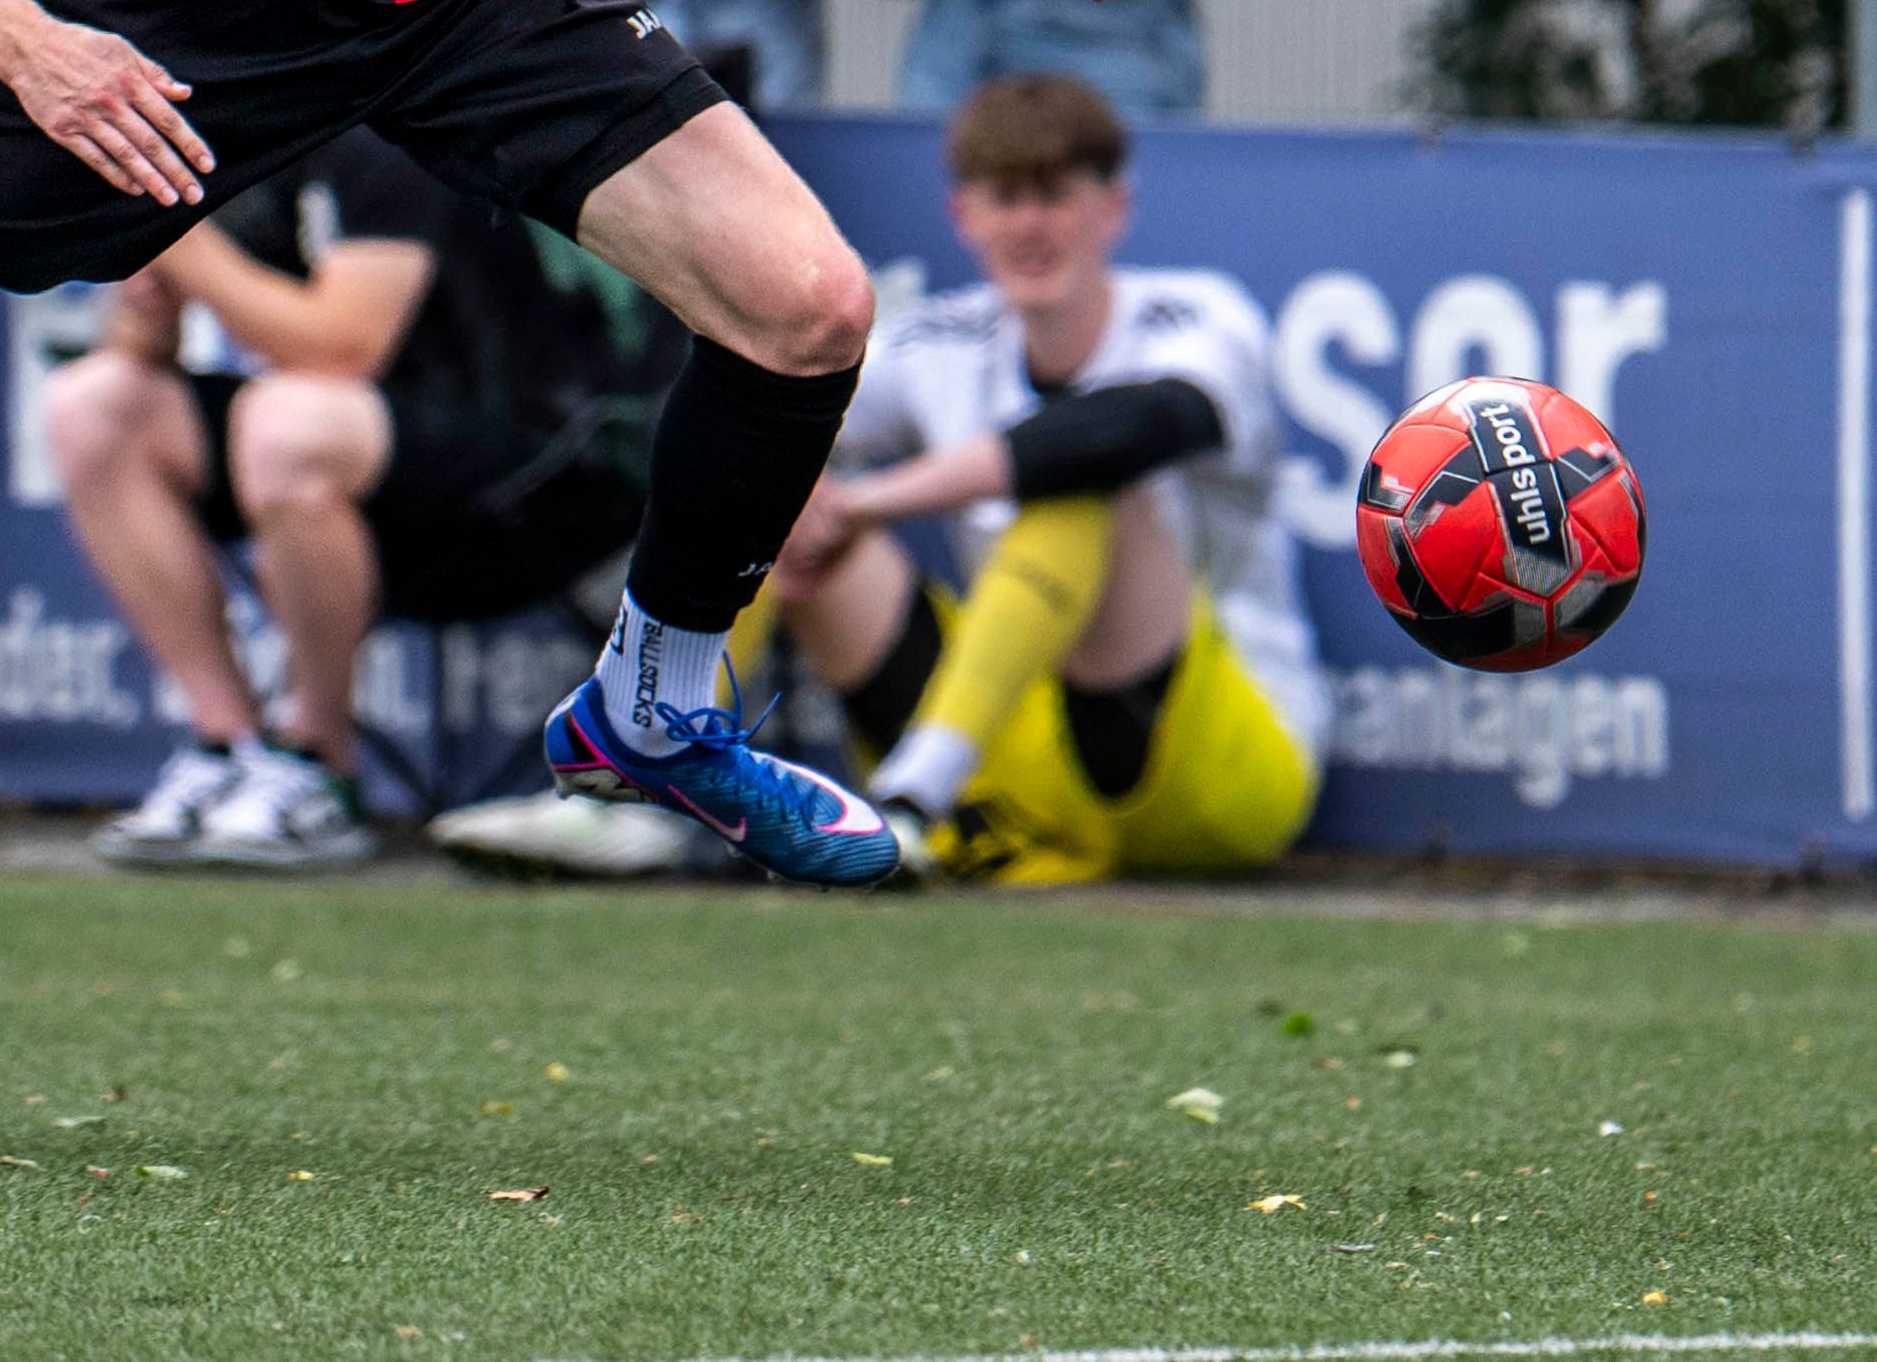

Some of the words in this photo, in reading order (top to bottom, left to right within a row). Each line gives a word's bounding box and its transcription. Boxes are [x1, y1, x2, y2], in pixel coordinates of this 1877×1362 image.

[1480, 404, 1552, 545] uhlsport
[631, 620, 665, 729] BALLSOCKS
[1322, 662, 1672, 808] anlagen
